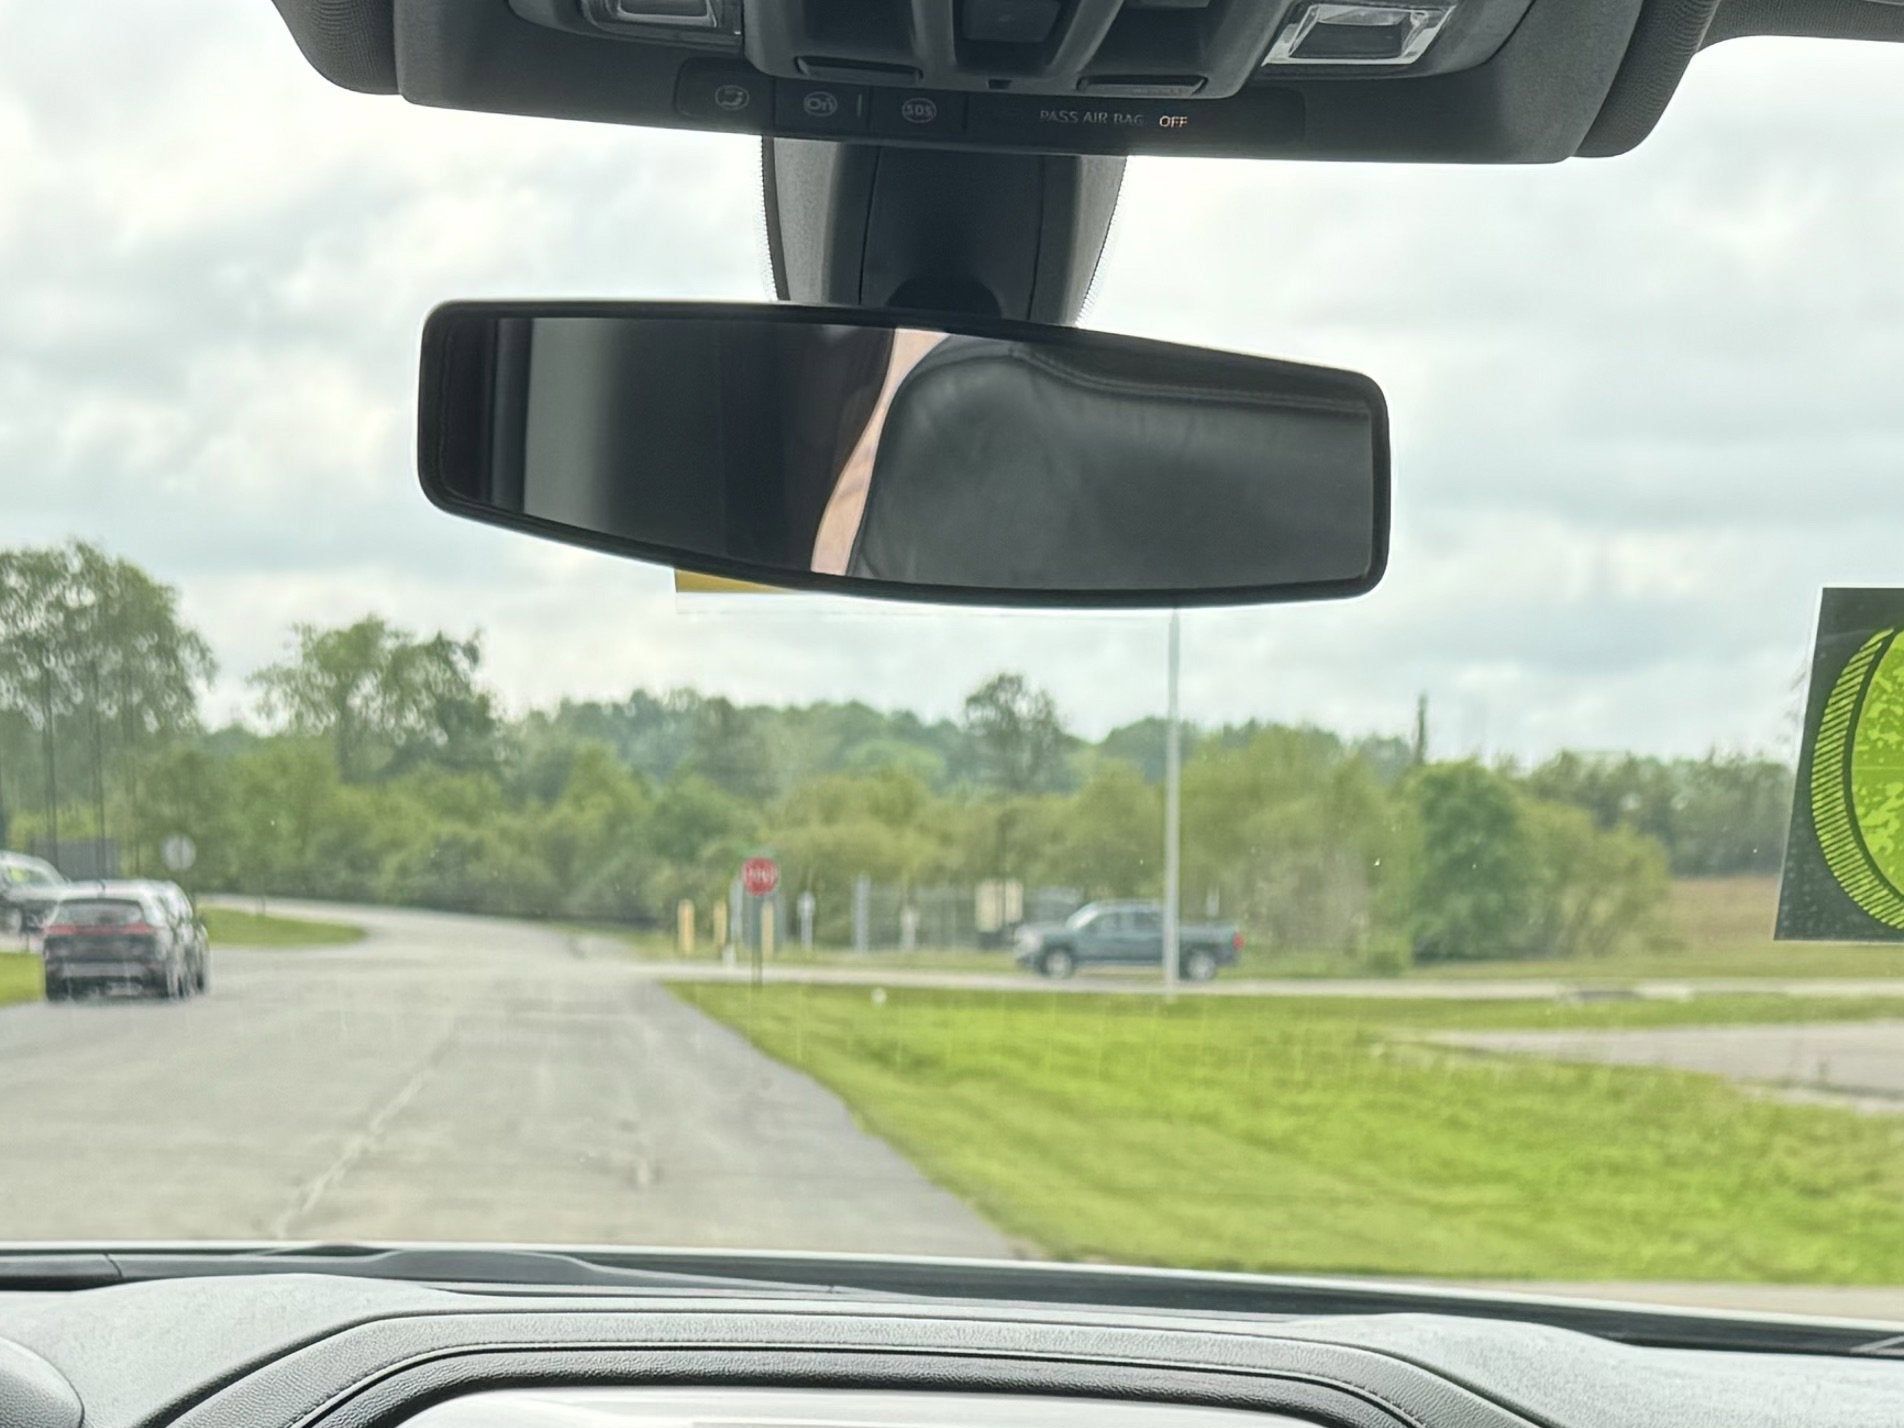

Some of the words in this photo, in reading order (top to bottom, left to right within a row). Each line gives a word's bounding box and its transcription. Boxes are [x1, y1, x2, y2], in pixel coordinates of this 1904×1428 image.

[903, 103, 935, 119] SOS
[1039, 109, 1078, 123] PASS
[1081, 110, 1109, 125] AIR
[1112, 113, 1144, 127] BAG
[1159, 115, 1188, 129] OFF
